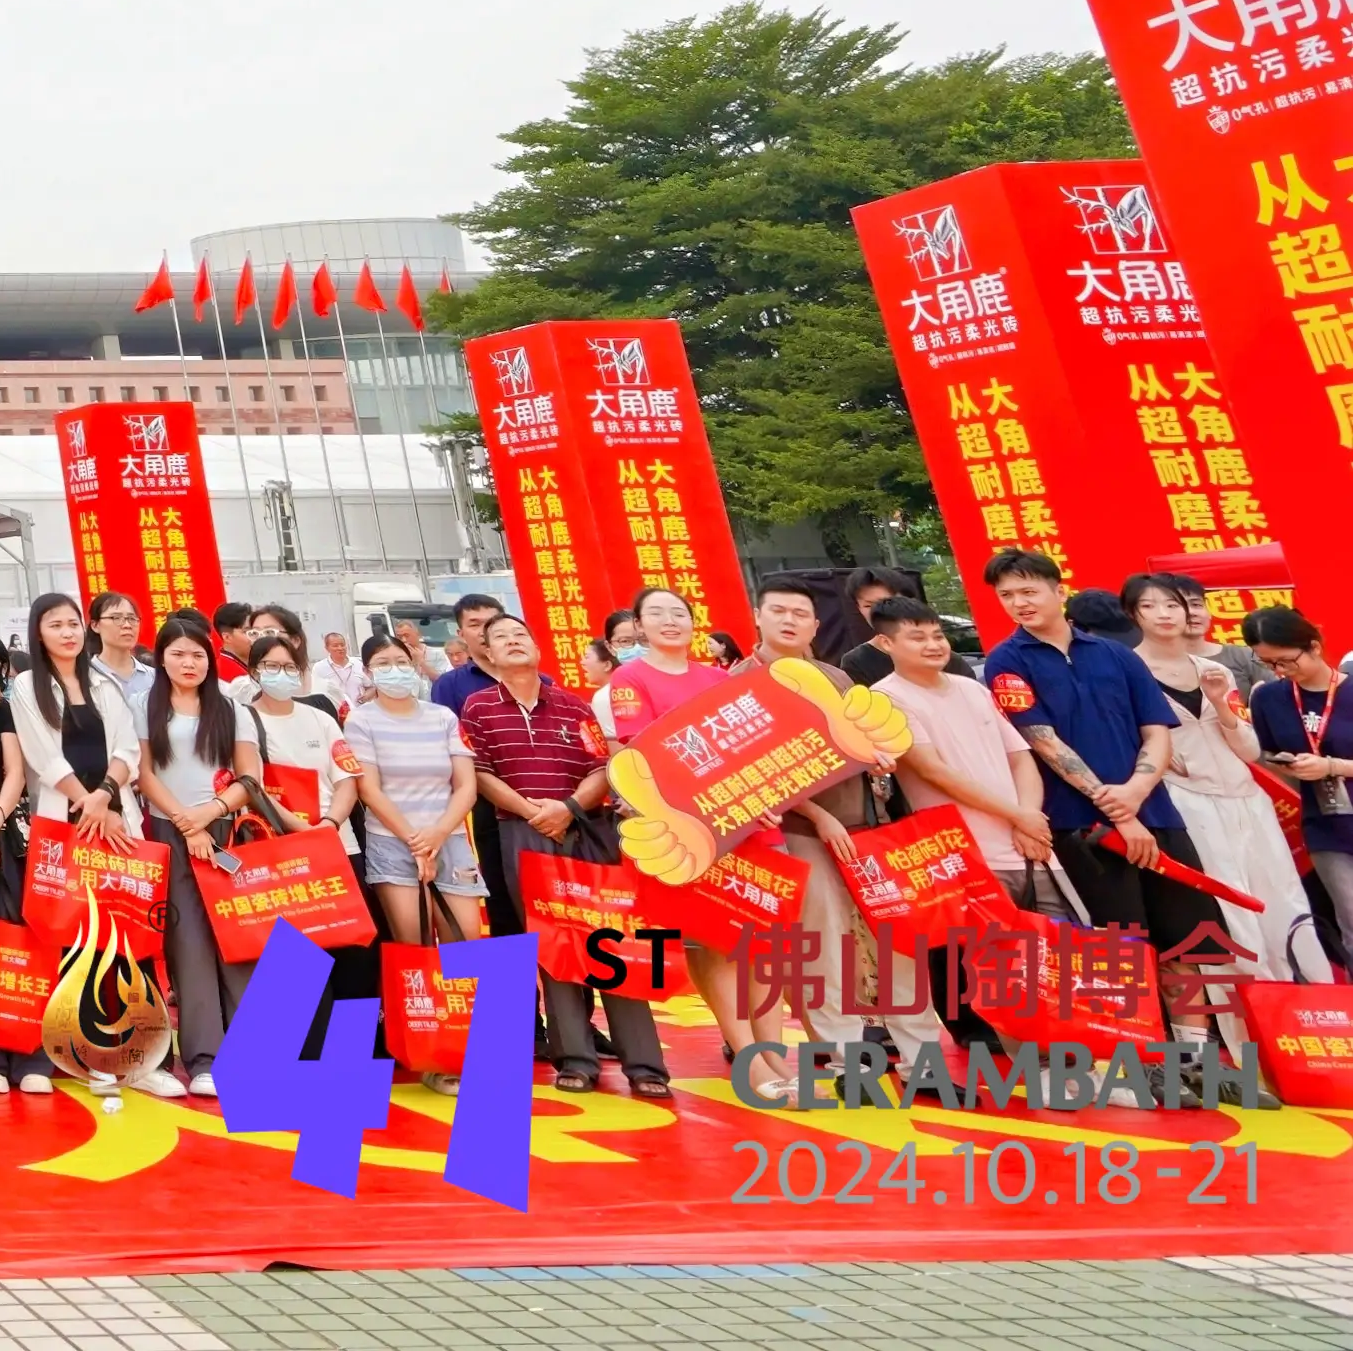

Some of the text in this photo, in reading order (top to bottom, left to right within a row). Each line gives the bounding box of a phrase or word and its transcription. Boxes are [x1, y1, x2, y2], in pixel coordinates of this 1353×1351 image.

[1274, 87, 1316, 112] 超抗污
[901, 272, 1014, 331] 大角鹿
[911, 316, 1019, 352] 超抗污柔光砖
[493, 395, 556, 430] 大角鹿
[586, 389, 680, 419] 大角鹿
[499, 426, 559, 445] 超抗污柔光砖
[592, 420, 683, 433] 超抗污柔光砖
[67, 457, 97, 483] 大角鹿
[119, 452, 189, 477] 大角鹿
[518, 468, 581, 688] 从超耐磨到超抗污
[701, 693, 765, 739] 大角鹿
[999, 695, 1028, 708] 021
[693, 728, 826, 816] 从超耐磨到超抗污
[711, 747, 846, 837] 大角鹿柔光敢称王
[72, 846, 164, 883] 怕瓷砖磨花
[80, 868, 154, 902] 用大角鹿
[214, 876, 348, 919] 中国瓷砖增长王
